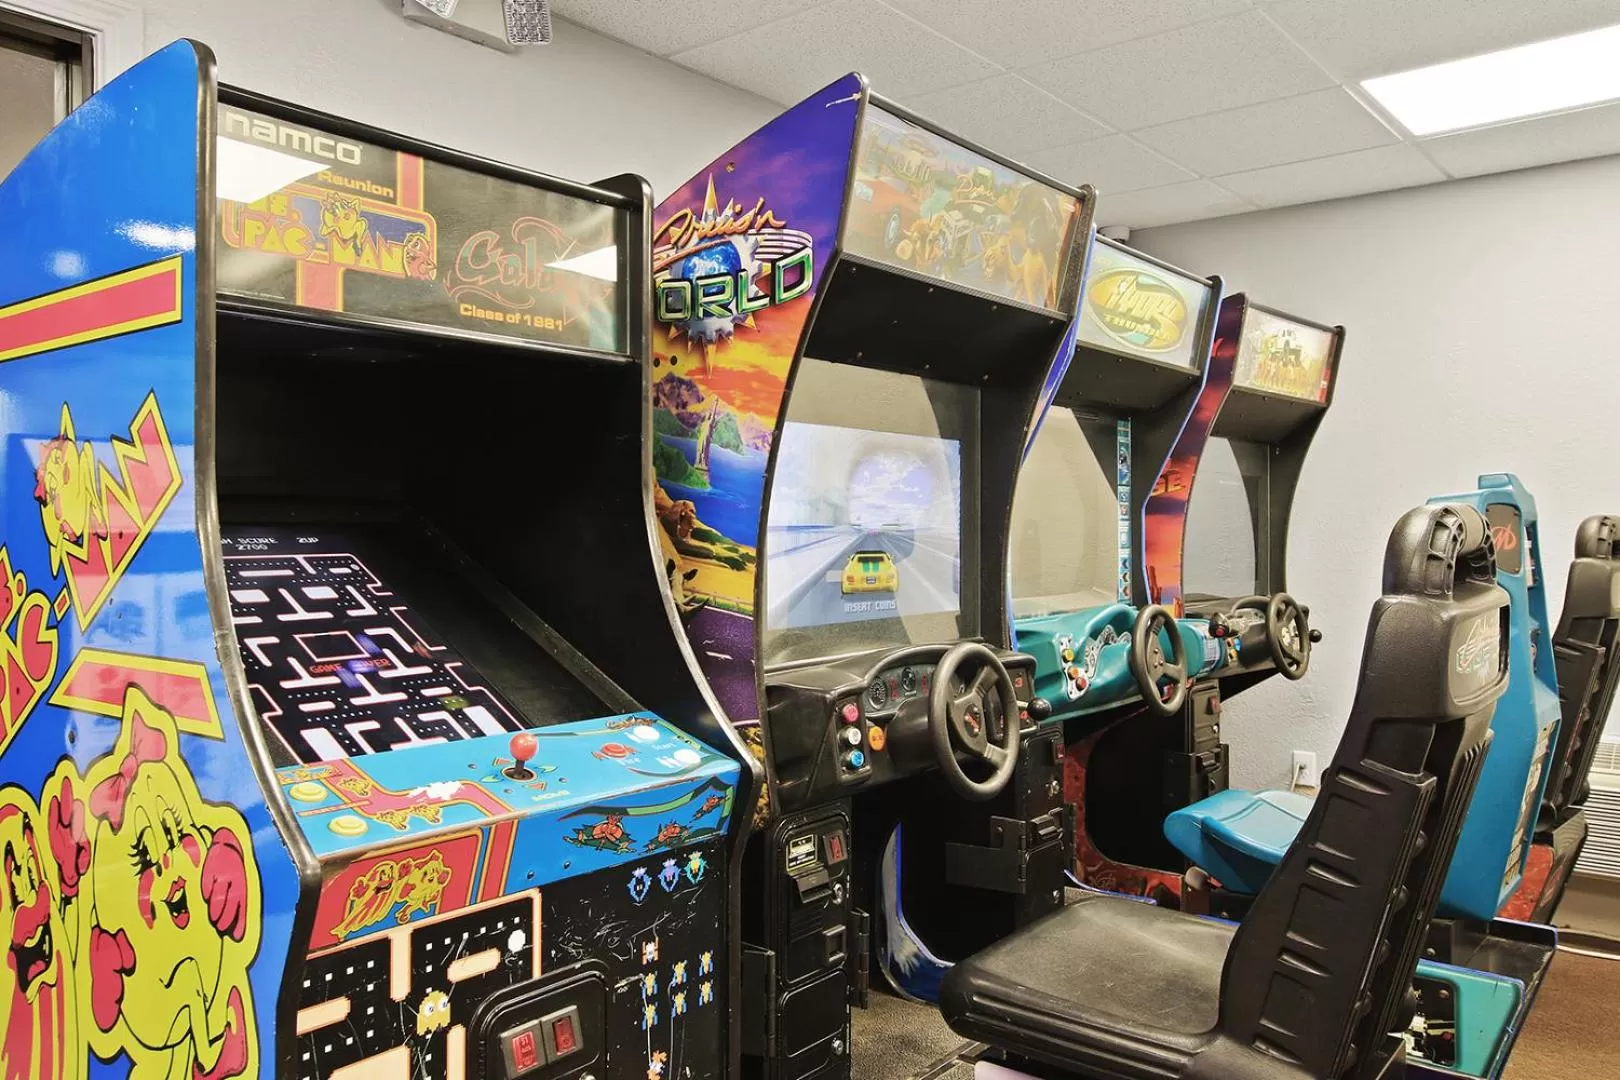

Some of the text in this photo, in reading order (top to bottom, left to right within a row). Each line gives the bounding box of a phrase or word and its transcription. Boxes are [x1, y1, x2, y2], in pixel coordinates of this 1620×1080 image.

[225, 111, 361, 165] namco
[318, 170, 394, 198] Reunion
[655, 248, 813, 322] ORLD
[506, 311, 521, 325] of
[523, 315, 563, 331] 1981
